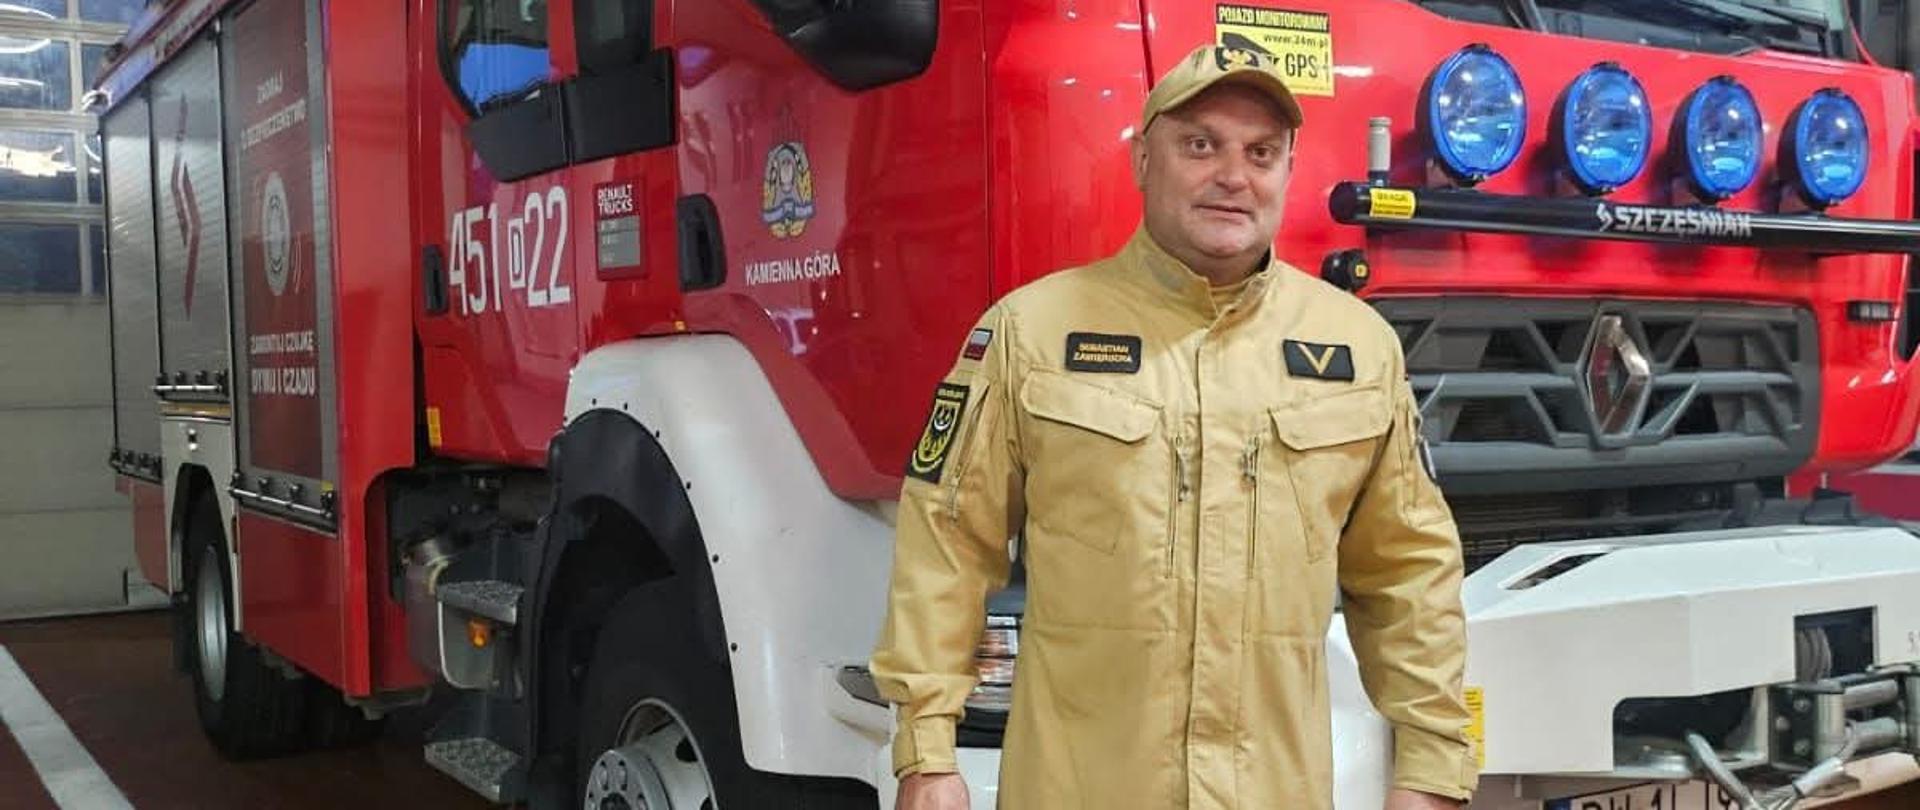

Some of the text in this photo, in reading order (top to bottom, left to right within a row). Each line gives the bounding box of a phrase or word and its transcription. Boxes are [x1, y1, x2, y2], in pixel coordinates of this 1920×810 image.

[1218, 6, 1255, 25] POJAZD
[1285, 53, 1318, 78] GPS
[598, 183, 633, 200] RENAULT
[598, 198, 633, 215] TRUCKS
[449, 202, 501, 316] 451
[524, 186, 570, 307] 22
[745, 249, 840, 286] KAMIENNA GÓRA
